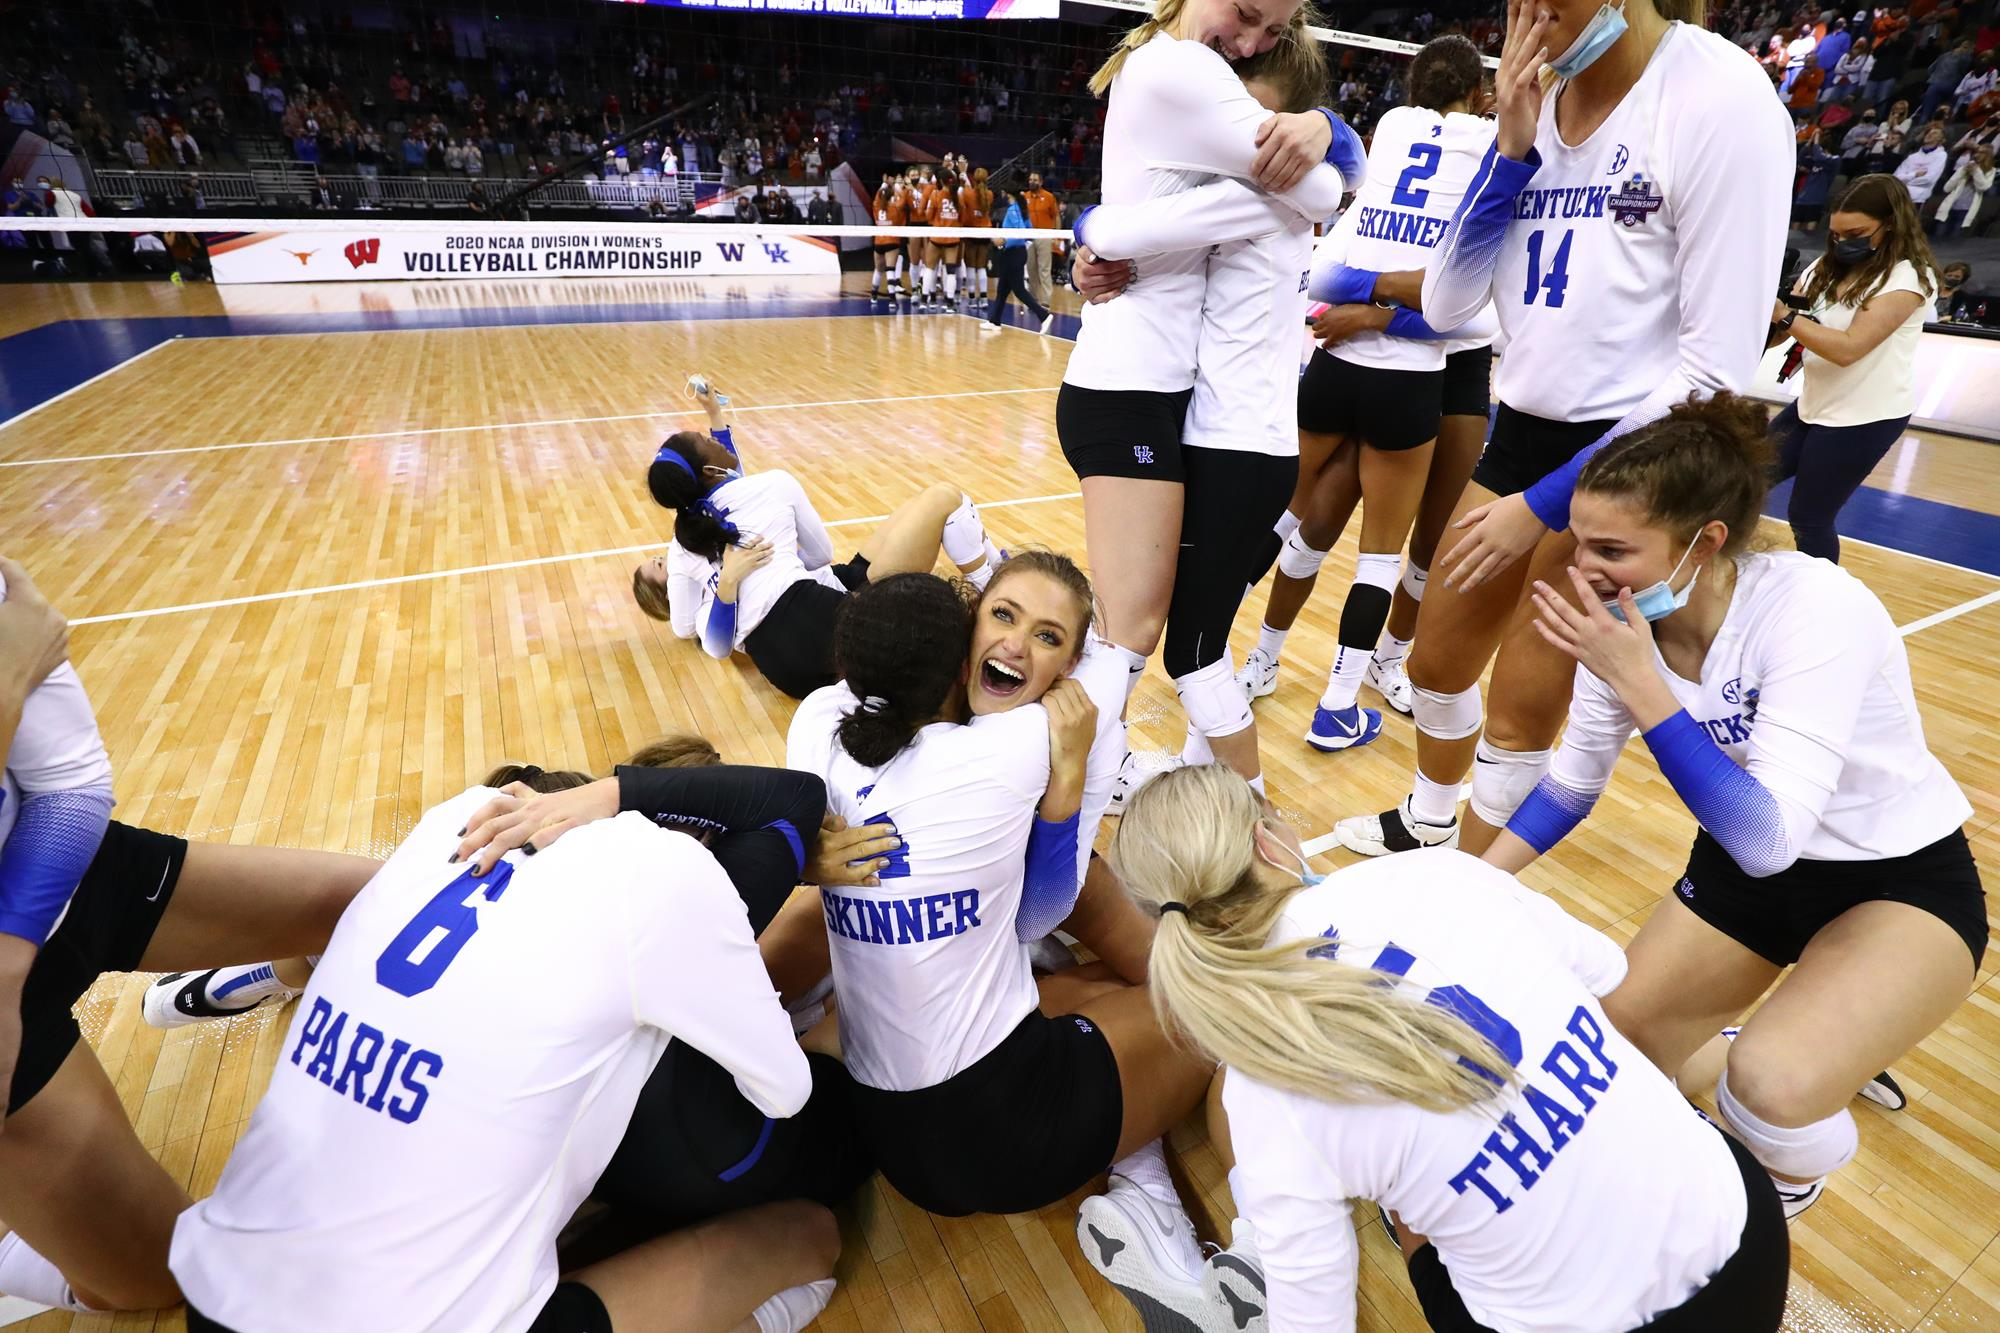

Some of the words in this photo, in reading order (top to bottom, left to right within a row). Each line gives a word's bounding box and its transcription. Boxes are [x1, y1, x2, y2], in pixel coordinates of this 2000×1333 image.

[1391, 142, 1442, 209] 2
[1610, 198, 1659, 208] CHAMPIONSHIP
[403, 251, 538, 272] VOLLEYBALL
[545, 250, 702, 271] CHAMPIONSHIP
[446, 236, 484, 250] 2020
[488, 236, 525, 249] NCAA
[531, 235, 590, 249] DIVISION
[594, 235, 599, 248] I
[602, 236, 662, 249] WOMEN'S
[716, 242, 745, 262] W
[762, 243, 790, 263] UK
[1523, 229, 1574, 308] 14
[1133, 445, 1154, 464] UK
[376, 859, 515, 998] 6
[822, 888, 982, 946] SKINNER
[291, 996, 444, 1125] PARIS
[1447, 1005, 1619, 1214] THARP
